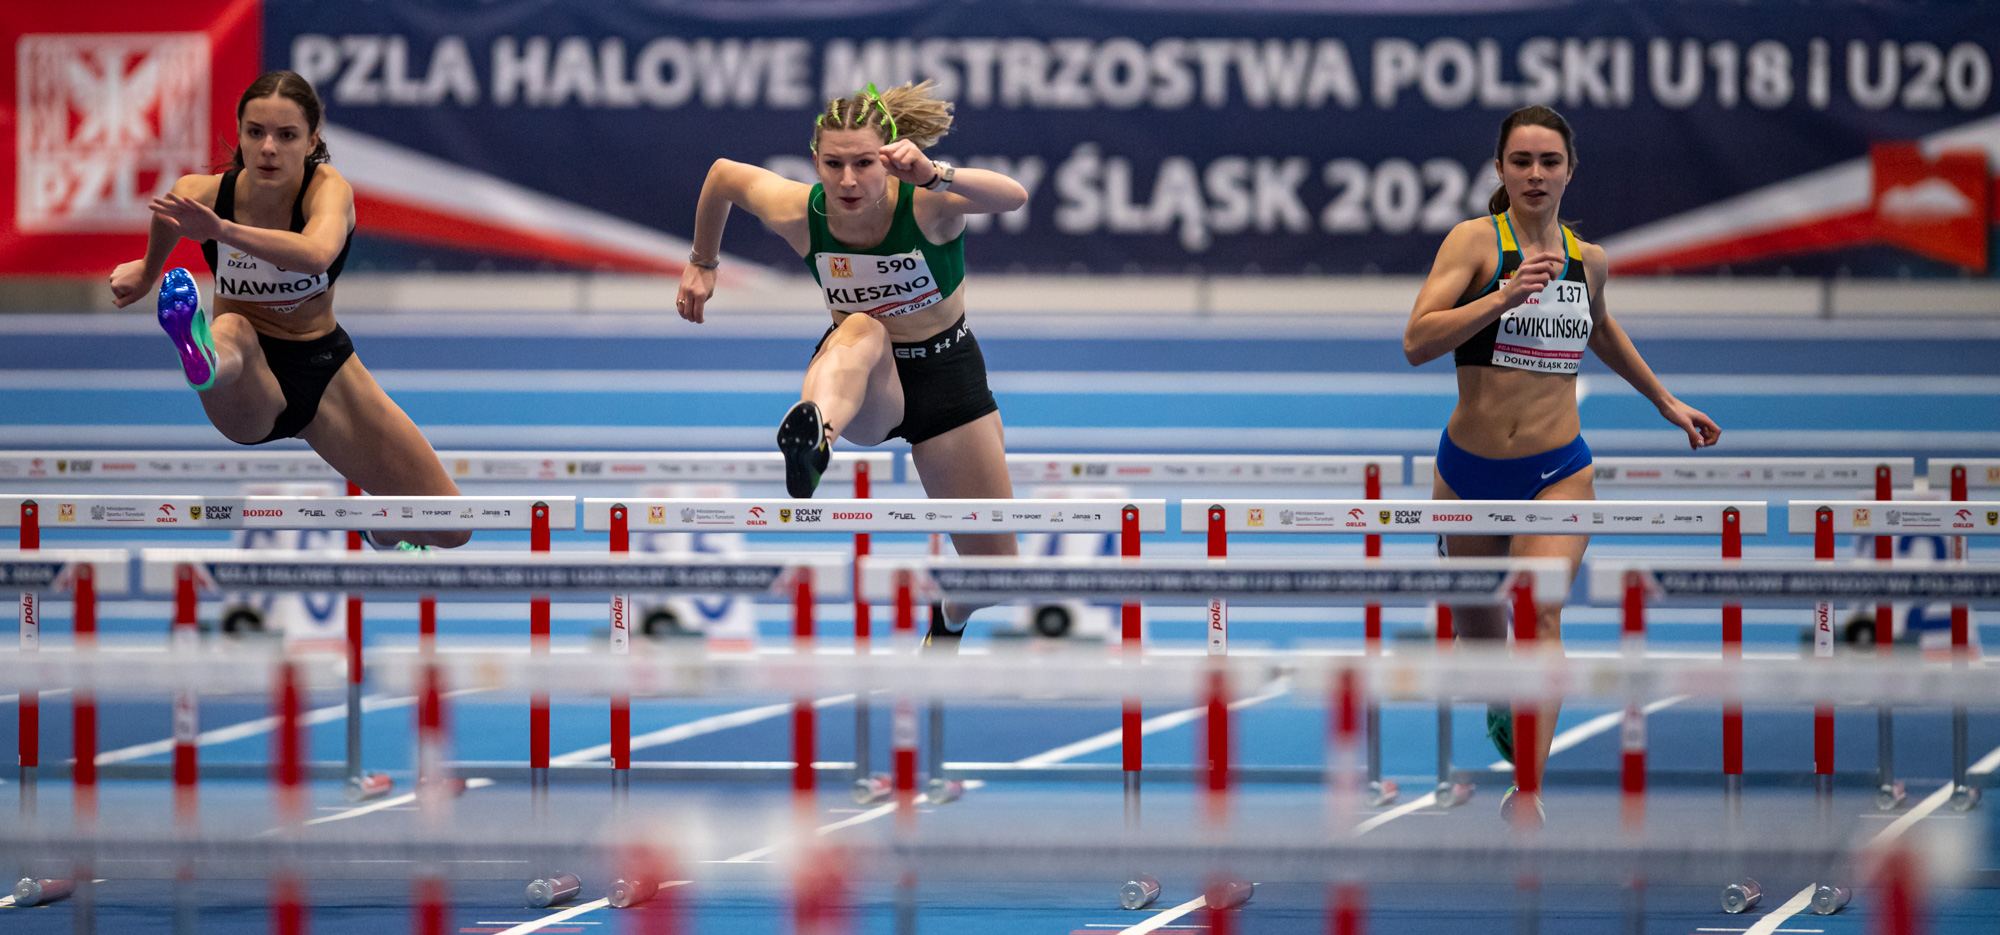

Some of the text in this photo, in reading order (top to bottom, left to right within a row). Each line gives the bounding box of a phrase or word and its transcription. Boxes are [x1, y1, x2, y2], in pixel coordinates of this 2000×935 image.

[291, 35, 1991, 107] PZLA HALOWE MISTRZOSTWA POLSKI U18 i U20
[1055, 143, 1309, 250] ŚLĄSK
[227, 259, 257, 270] DZLA
[876, 257, 917, 274] 590
[220, 274, 321, 296] NAWROT
[826, 275, 930, 304] KLESZNO
[1556, 284, 1582, 304] 137
[908, 299, 932, 312] 2024
[1504, 312, 1588, 340] ĆWIKLIŃSKA
[1503, 355, 1536, 368] DOLNY
[1537, 358, 1562, 371] ŚLĄSK
[205, 505, 233, 513] DOLNY
[205, 511, 231, 520] ŚLĄSK
[242, 509, 283, 517] BODZIO
[795, 508, 823, 516] DOLNY
[832, 512, 873, 520] BODZIO
[1394, 510, 1422, 518] DOLNY
[795, 514, 821, 523] ŚLĄSK
[1432, 514, 1473, 522] BODZIO
[23, 591, 36, 625] pola
[1210, 600, 1223, 631] pola
[1818, 602, 1830, 633] pola
